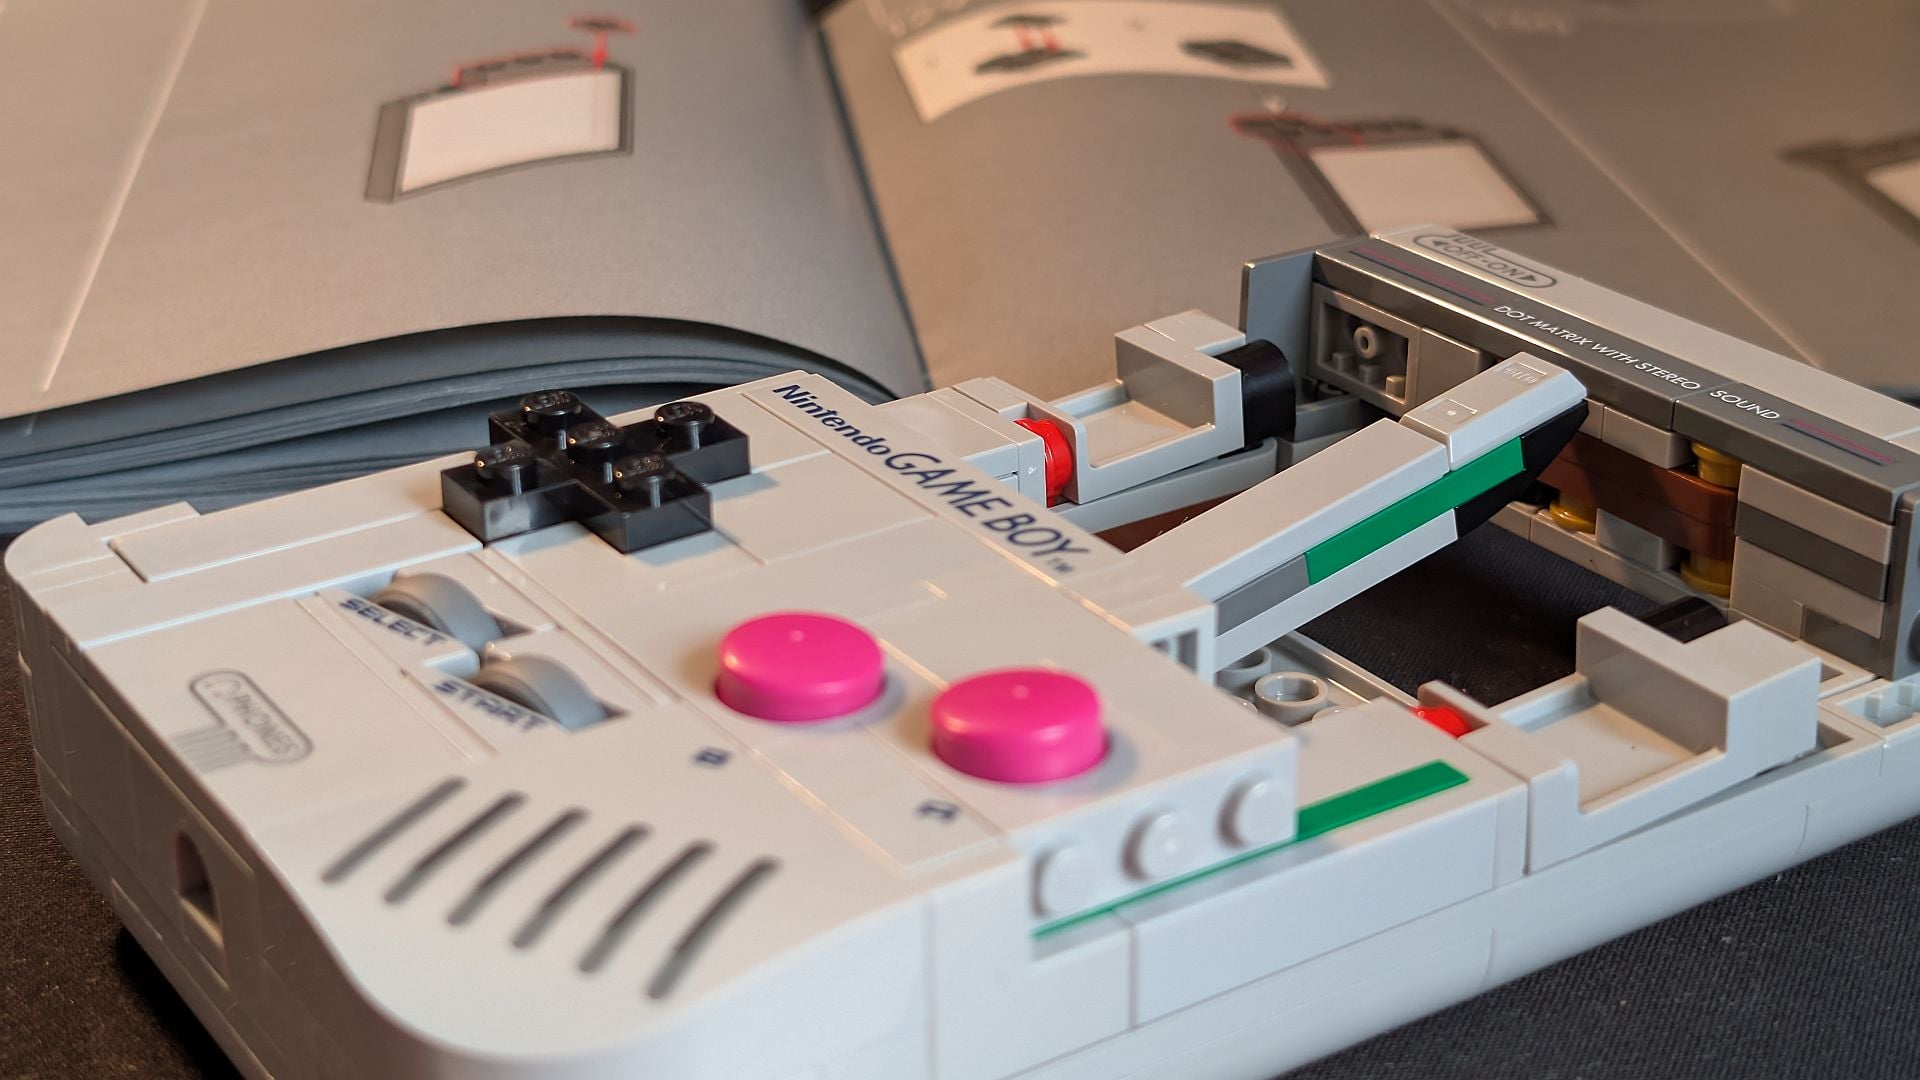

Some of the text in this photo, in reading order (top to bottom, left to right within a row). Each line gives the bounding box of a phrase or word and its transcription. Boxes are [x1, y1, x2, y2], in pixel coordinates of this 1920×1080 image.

[1493, 305, 1780, 420] DOT MATRIX WITH STEREO SOUND
[772, 384, 891, 455] Nintendo
[884, 453, 1014, 518] GAME
[981, 513, 1091, 558] BOY
[339, 597, 446, 645] SELECT
[433, 679, 546, 731] START
